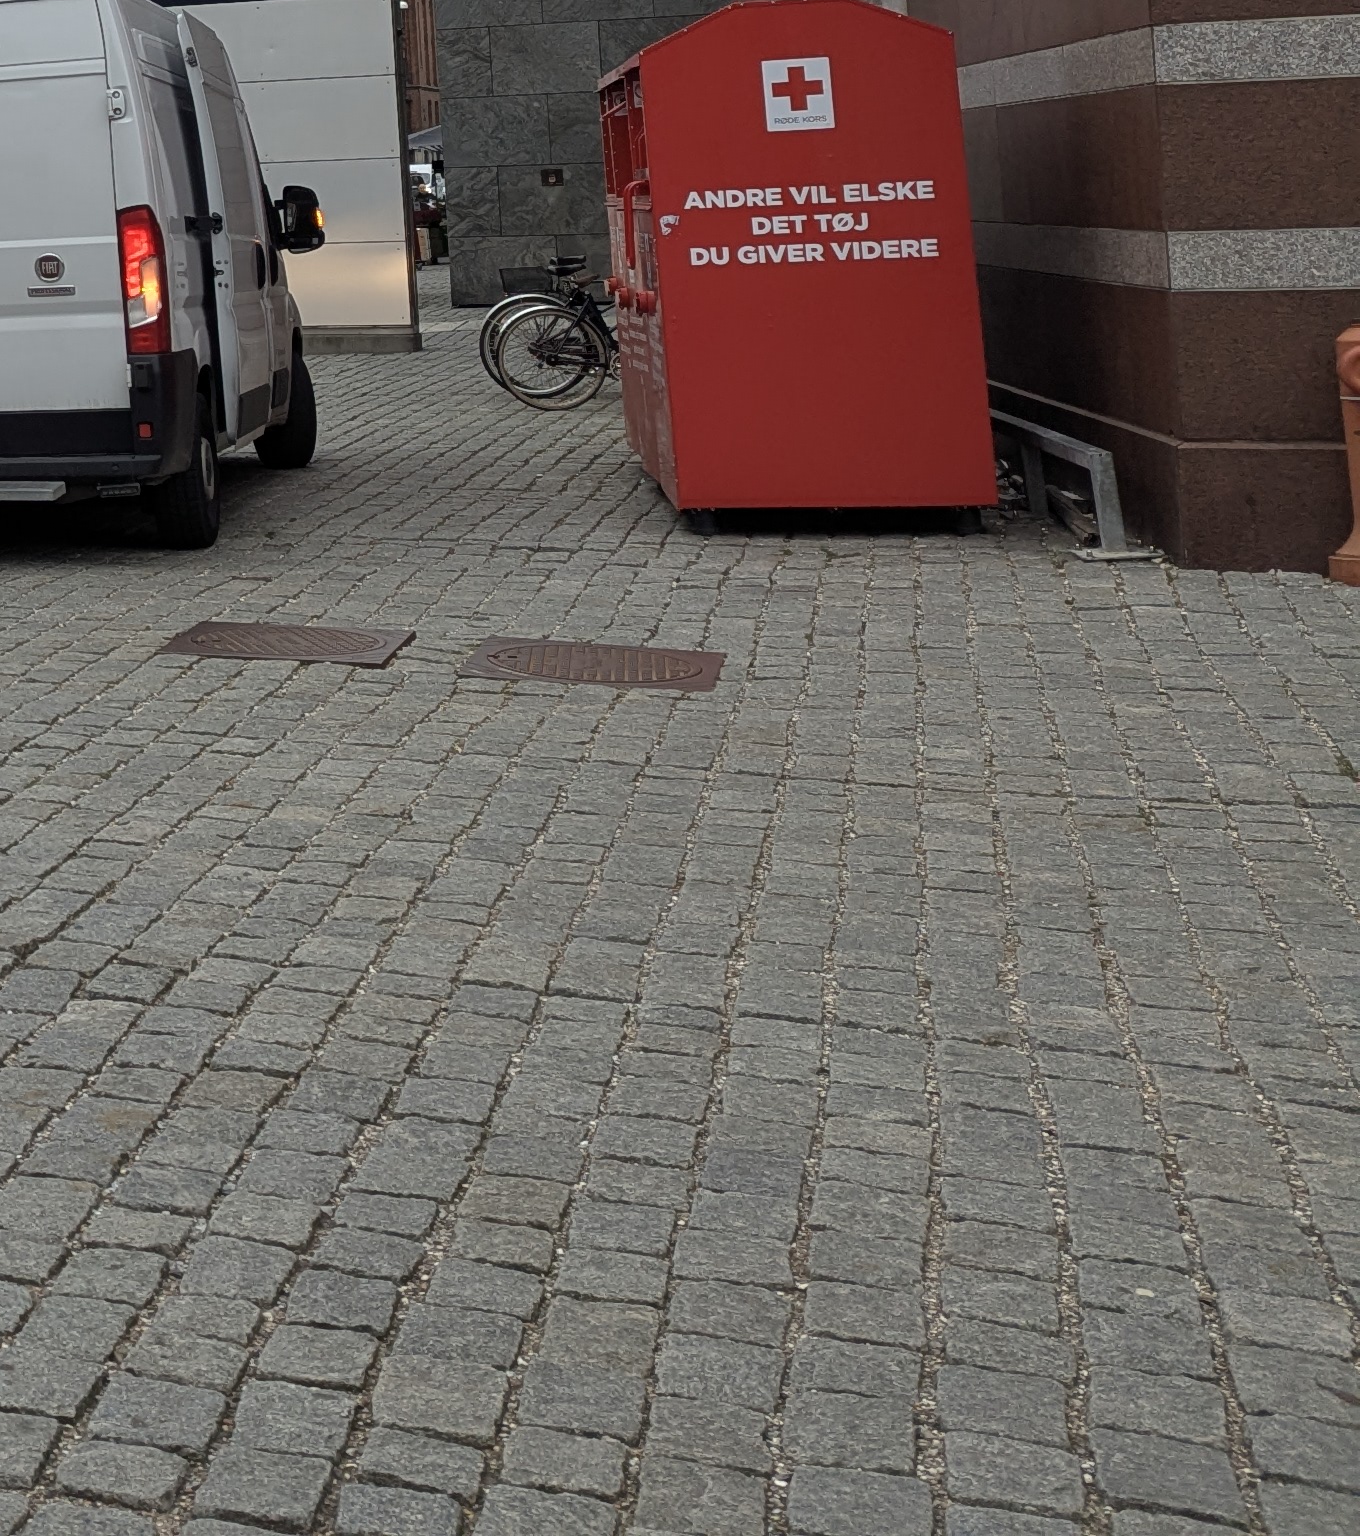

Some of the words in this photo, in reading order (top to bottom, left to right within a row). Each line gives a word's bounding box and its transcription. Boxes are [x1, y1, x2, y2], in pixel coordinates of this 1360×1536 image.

[774, 116, 800, 124] RØDE
[803, 115, 827, 123] KORS
[684, 187, 783, 209] ANDRE
[789, 185, 836, 205] VIL
[843, 180, 935, 202] ELSKE
[751, 214, 807, 235] DET
[814, 212, 869, 233] TØJ
[689, 246, 730, 266] DU
[737, 243, 825, 264] GIVER
[830, 238, 939, 261] VIDERE
[42, 261, 58, 274] FIAT
